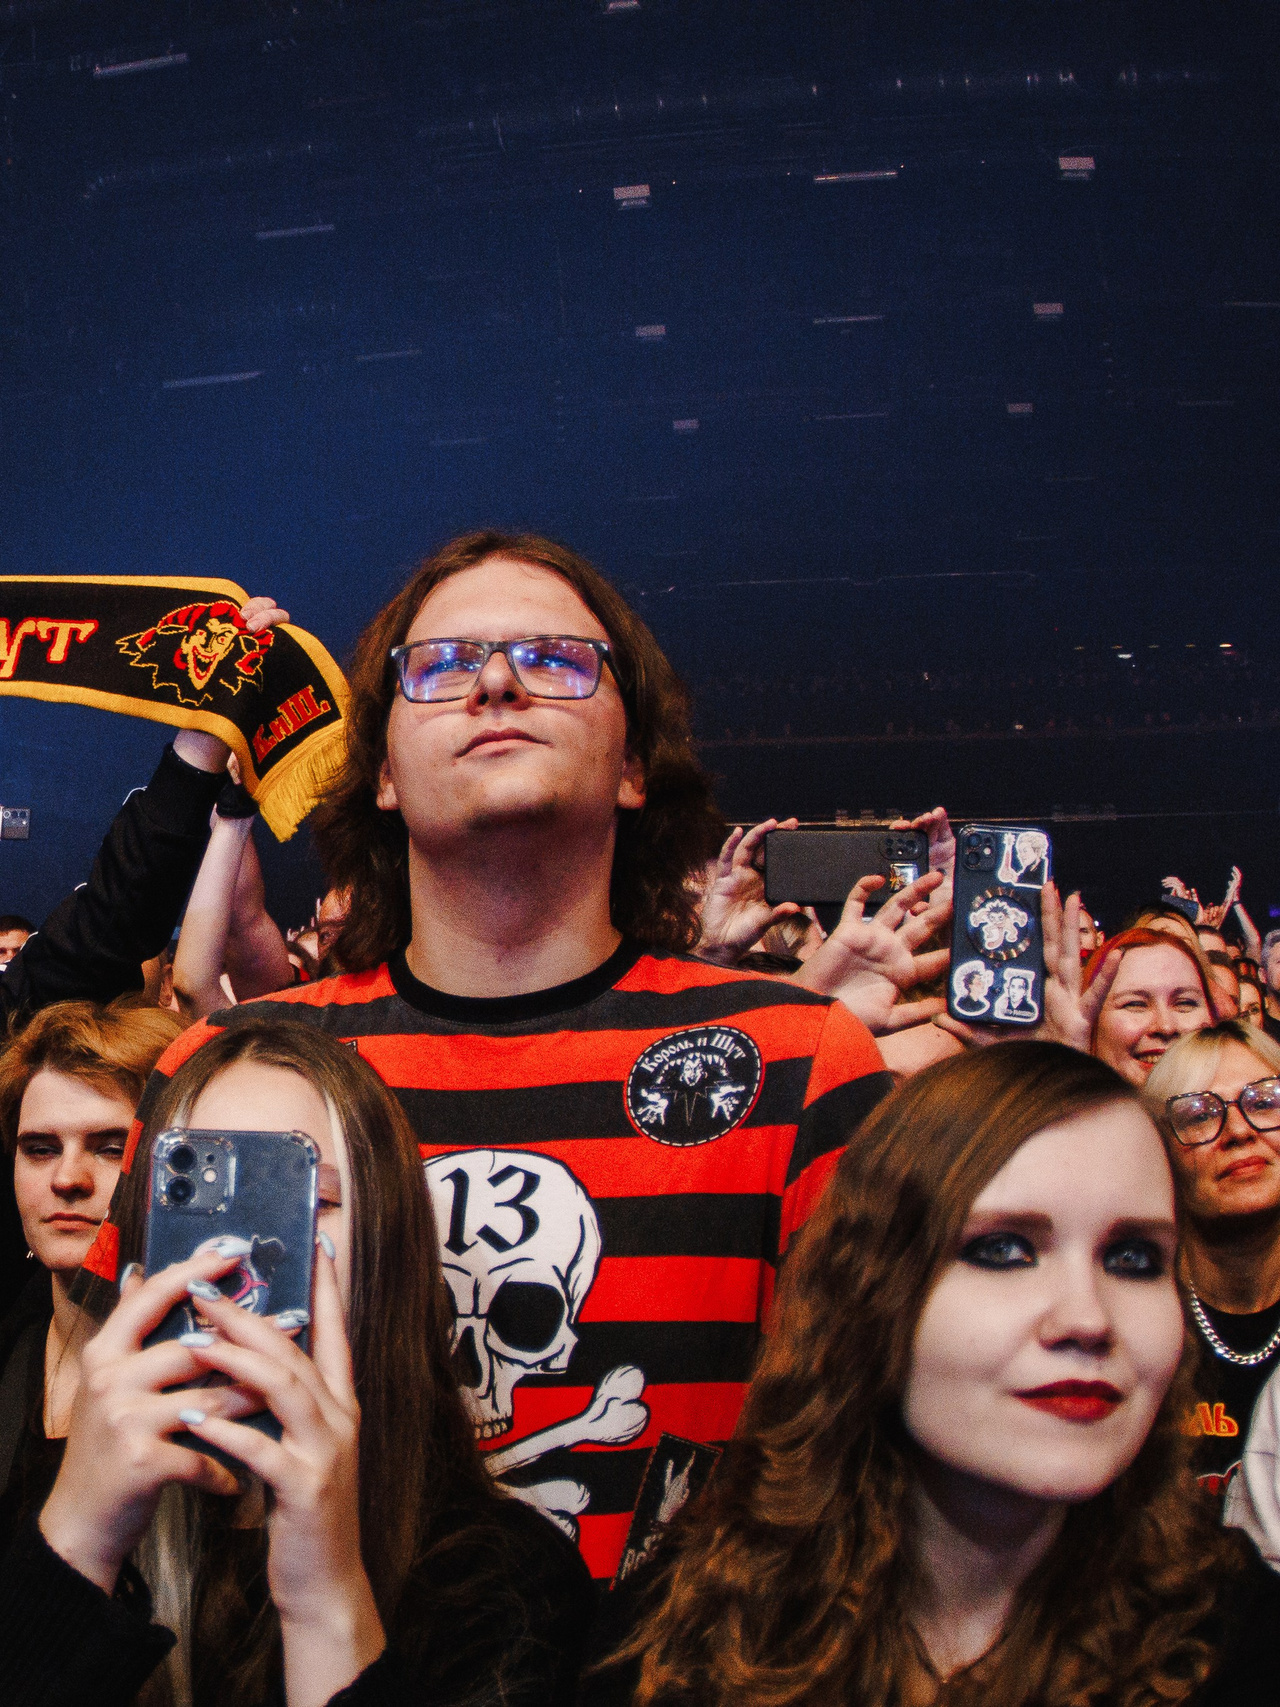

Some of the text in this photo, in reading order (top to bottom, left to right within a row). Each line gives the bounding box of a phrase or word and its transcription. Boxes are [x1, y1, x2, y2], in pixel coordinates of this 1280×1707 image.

[639, 1032, 747, 1073] Король и Шут
[439, 1164, 542, 1257] 13
